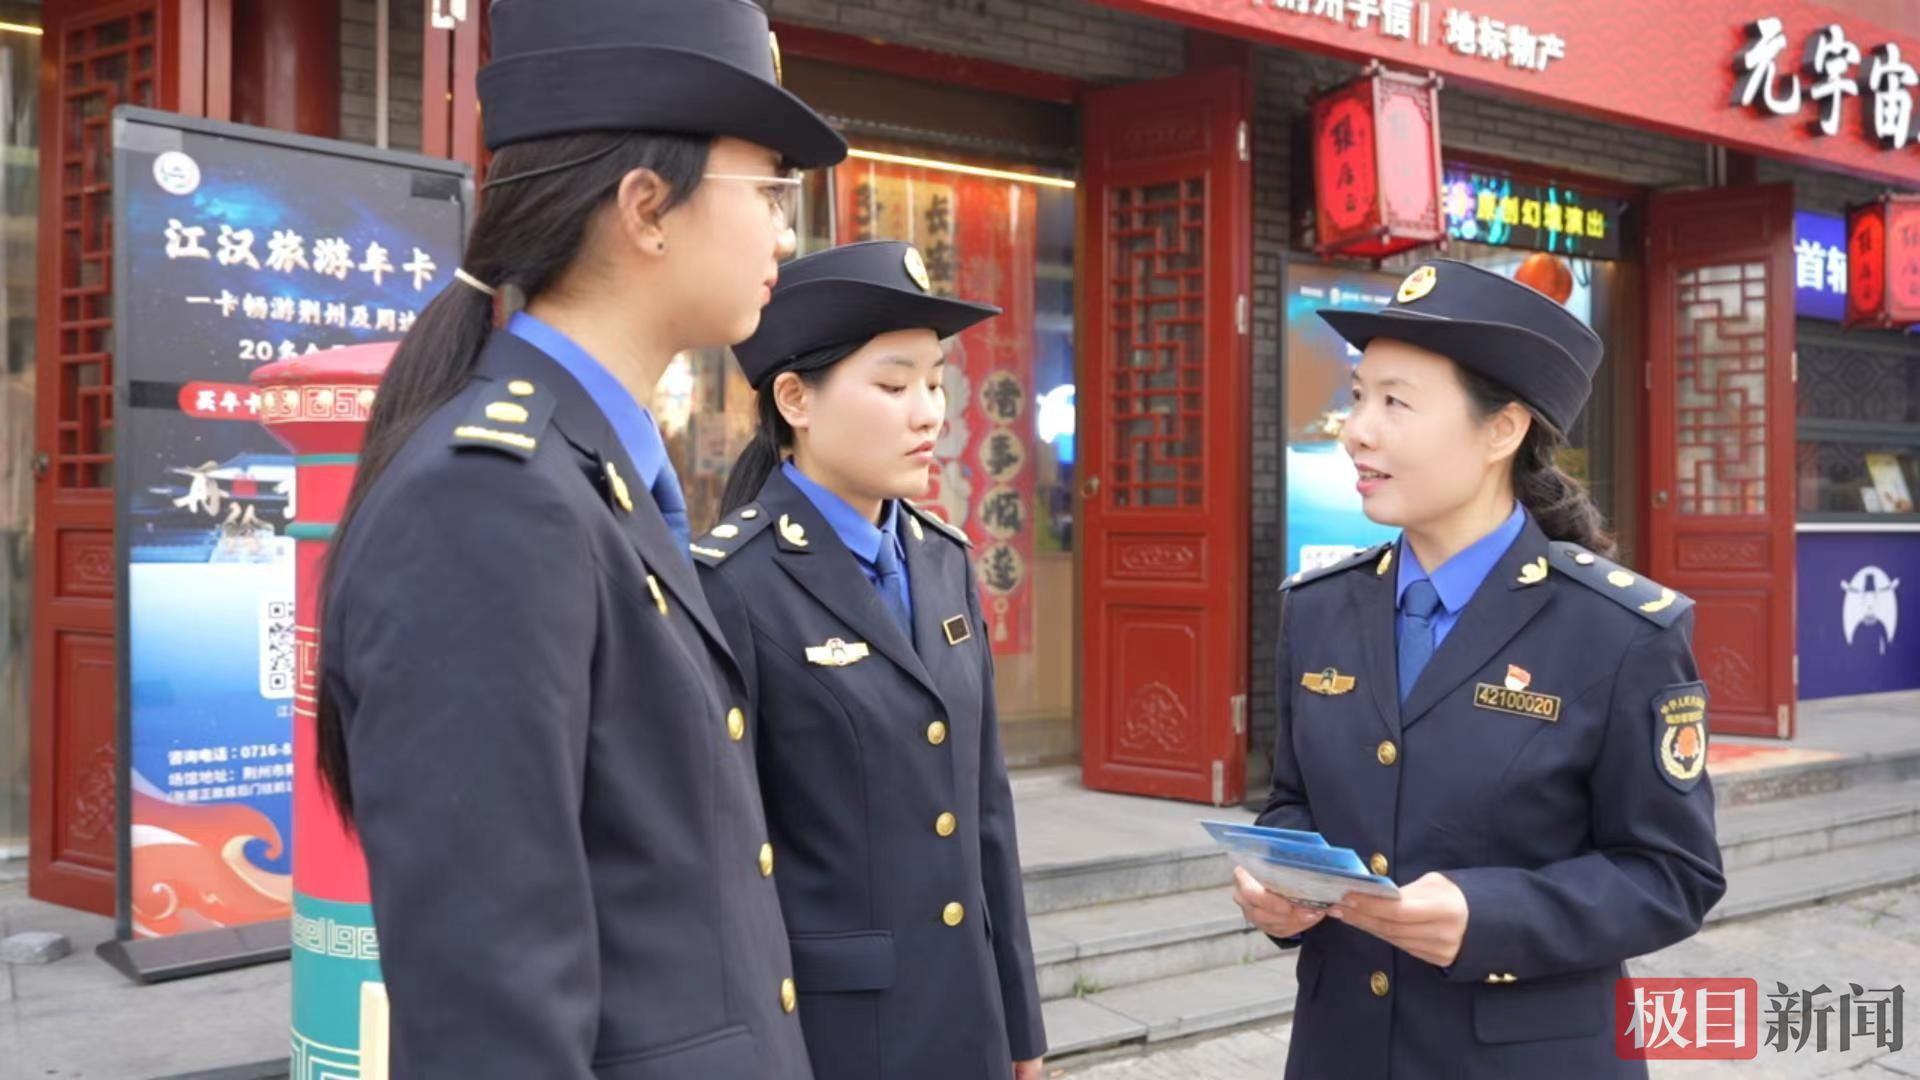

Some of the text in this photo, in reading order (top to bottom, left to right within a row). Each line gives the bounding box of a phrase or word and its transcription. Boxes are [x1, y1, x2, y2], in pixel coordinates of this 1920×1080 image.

[1446, 8, 1565, 71] 地标物产
[1742, 16, 1919, 149] 元宇宙
[164, 218, 437, 291] 江汉旅游年卡
[1479, 686, 1554, 716] 42100020
